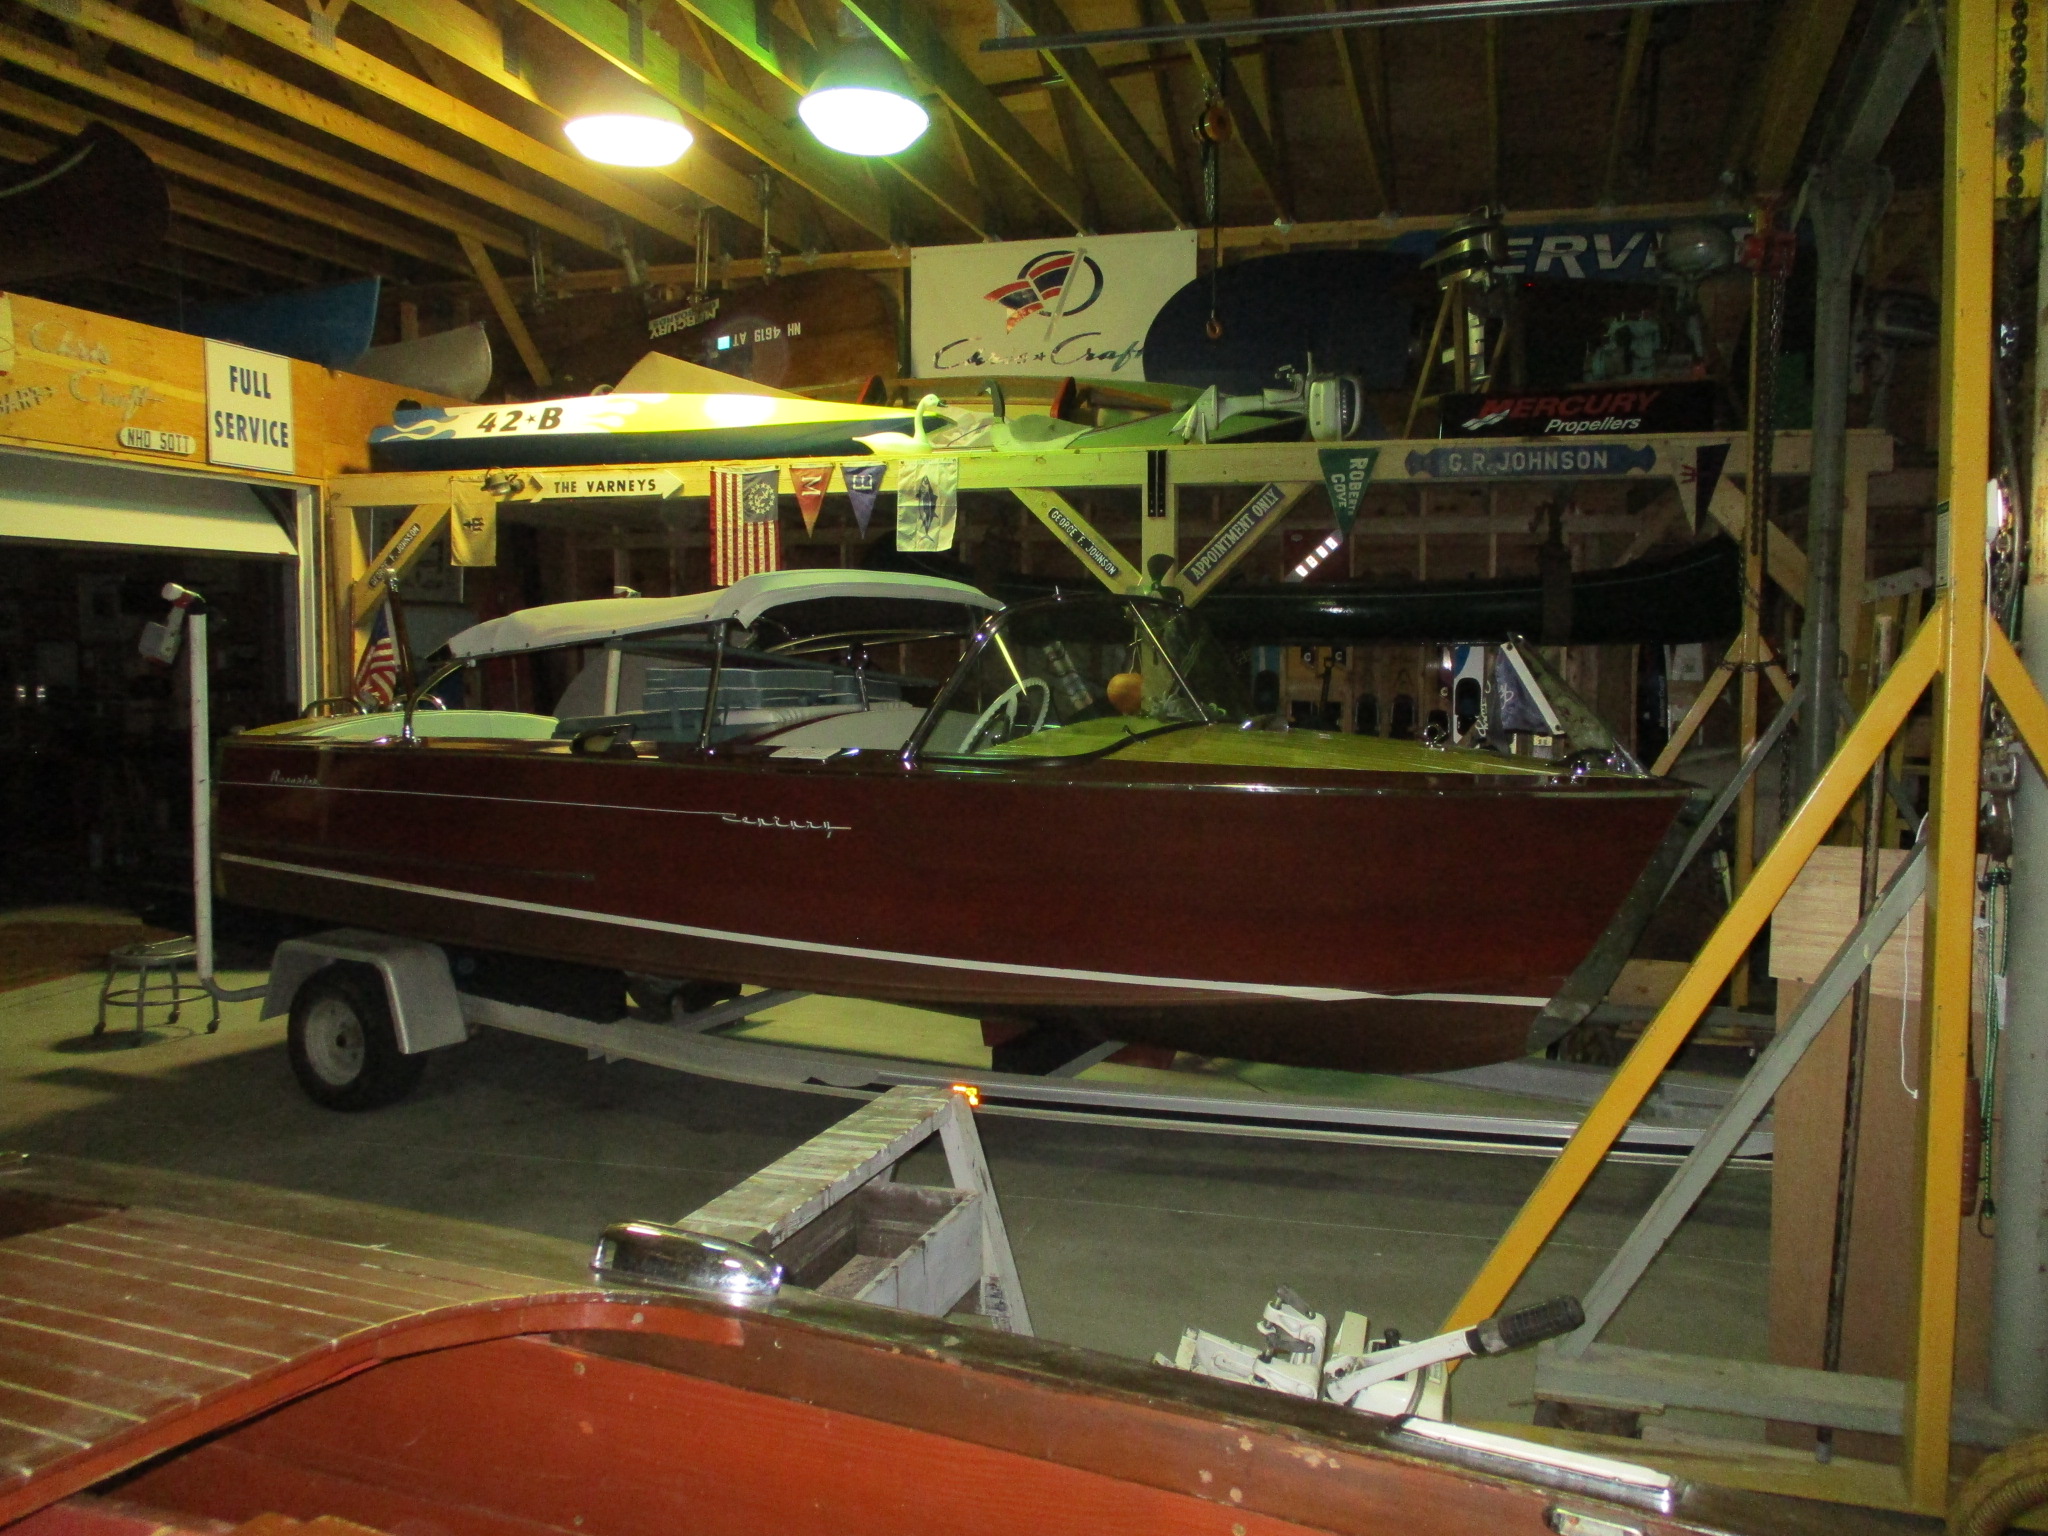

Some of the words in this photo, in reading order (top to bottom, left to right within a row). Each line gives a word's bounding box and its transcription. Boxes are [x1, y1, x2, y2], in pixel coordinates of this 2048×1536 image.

[733, 331, 747, 347] AT
[754, 326, 781, 342] 4619
[787, 322, 801, 337] NH
[229, 365, 271, 399] FULL
[1478, 391, 1662, 418] MERCURY
[214, 410, 289, 449] SERVICE
[1544, 416, 1642, 435] Propellers
[1498, 450, 1608, 472] JOHNSON
[554, 481, 577, 494] THE
[586, 479, 656, 493] VARNEYS
[1331, 473, 1347, 509] COVE
[396, 525, 421, 554] JOHNSON
[1051, 510, 1079, 539] GEORGE
[1085, 541, 1117, 577] JOHNSON
[1190, 512, 1257, 581] APPOINTMENT
[1251, 487, 1280, 518] ONLY
